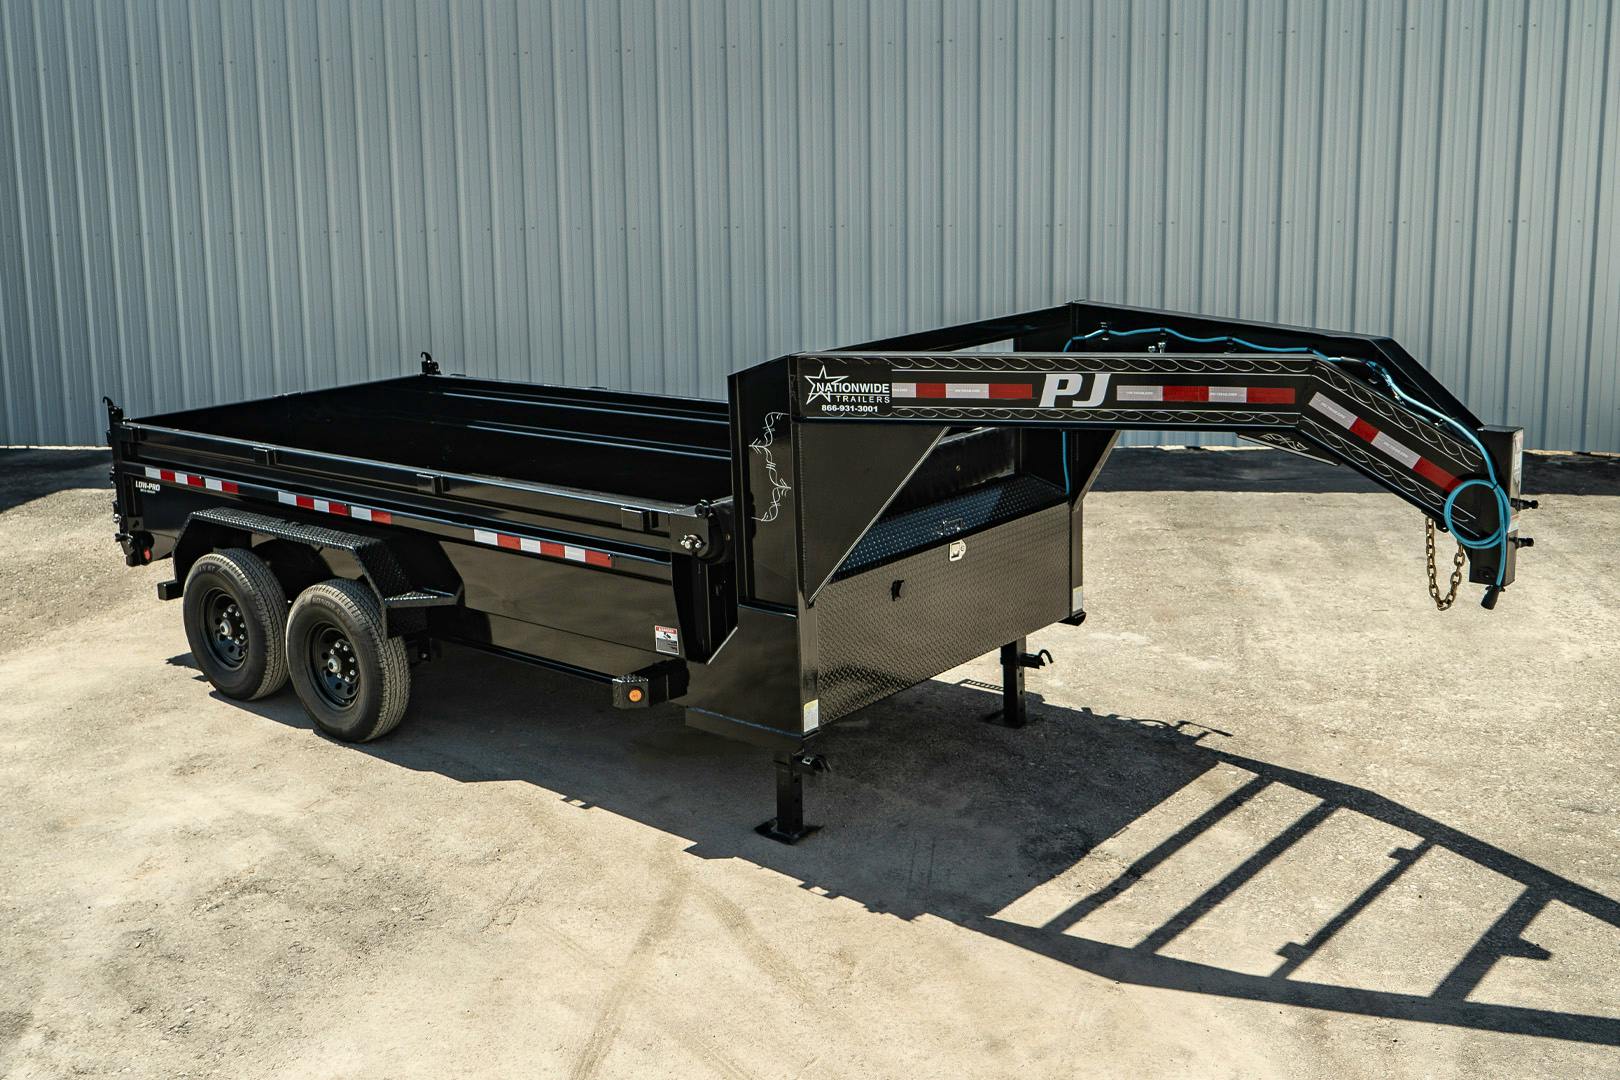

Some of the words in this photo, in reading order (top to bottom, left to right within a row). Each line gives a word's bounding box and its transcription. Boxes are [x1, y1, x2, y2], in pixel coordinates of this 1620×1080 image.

[816, 382, 890, 394] NATIONWIDE
[1038, 373, 1111, 408] PJ
[835, 395, 890, 404] TRAILERS
[821, 404, 878, 413] 866-931-3001
[135, 480, 160, 491] LOW-PRO
